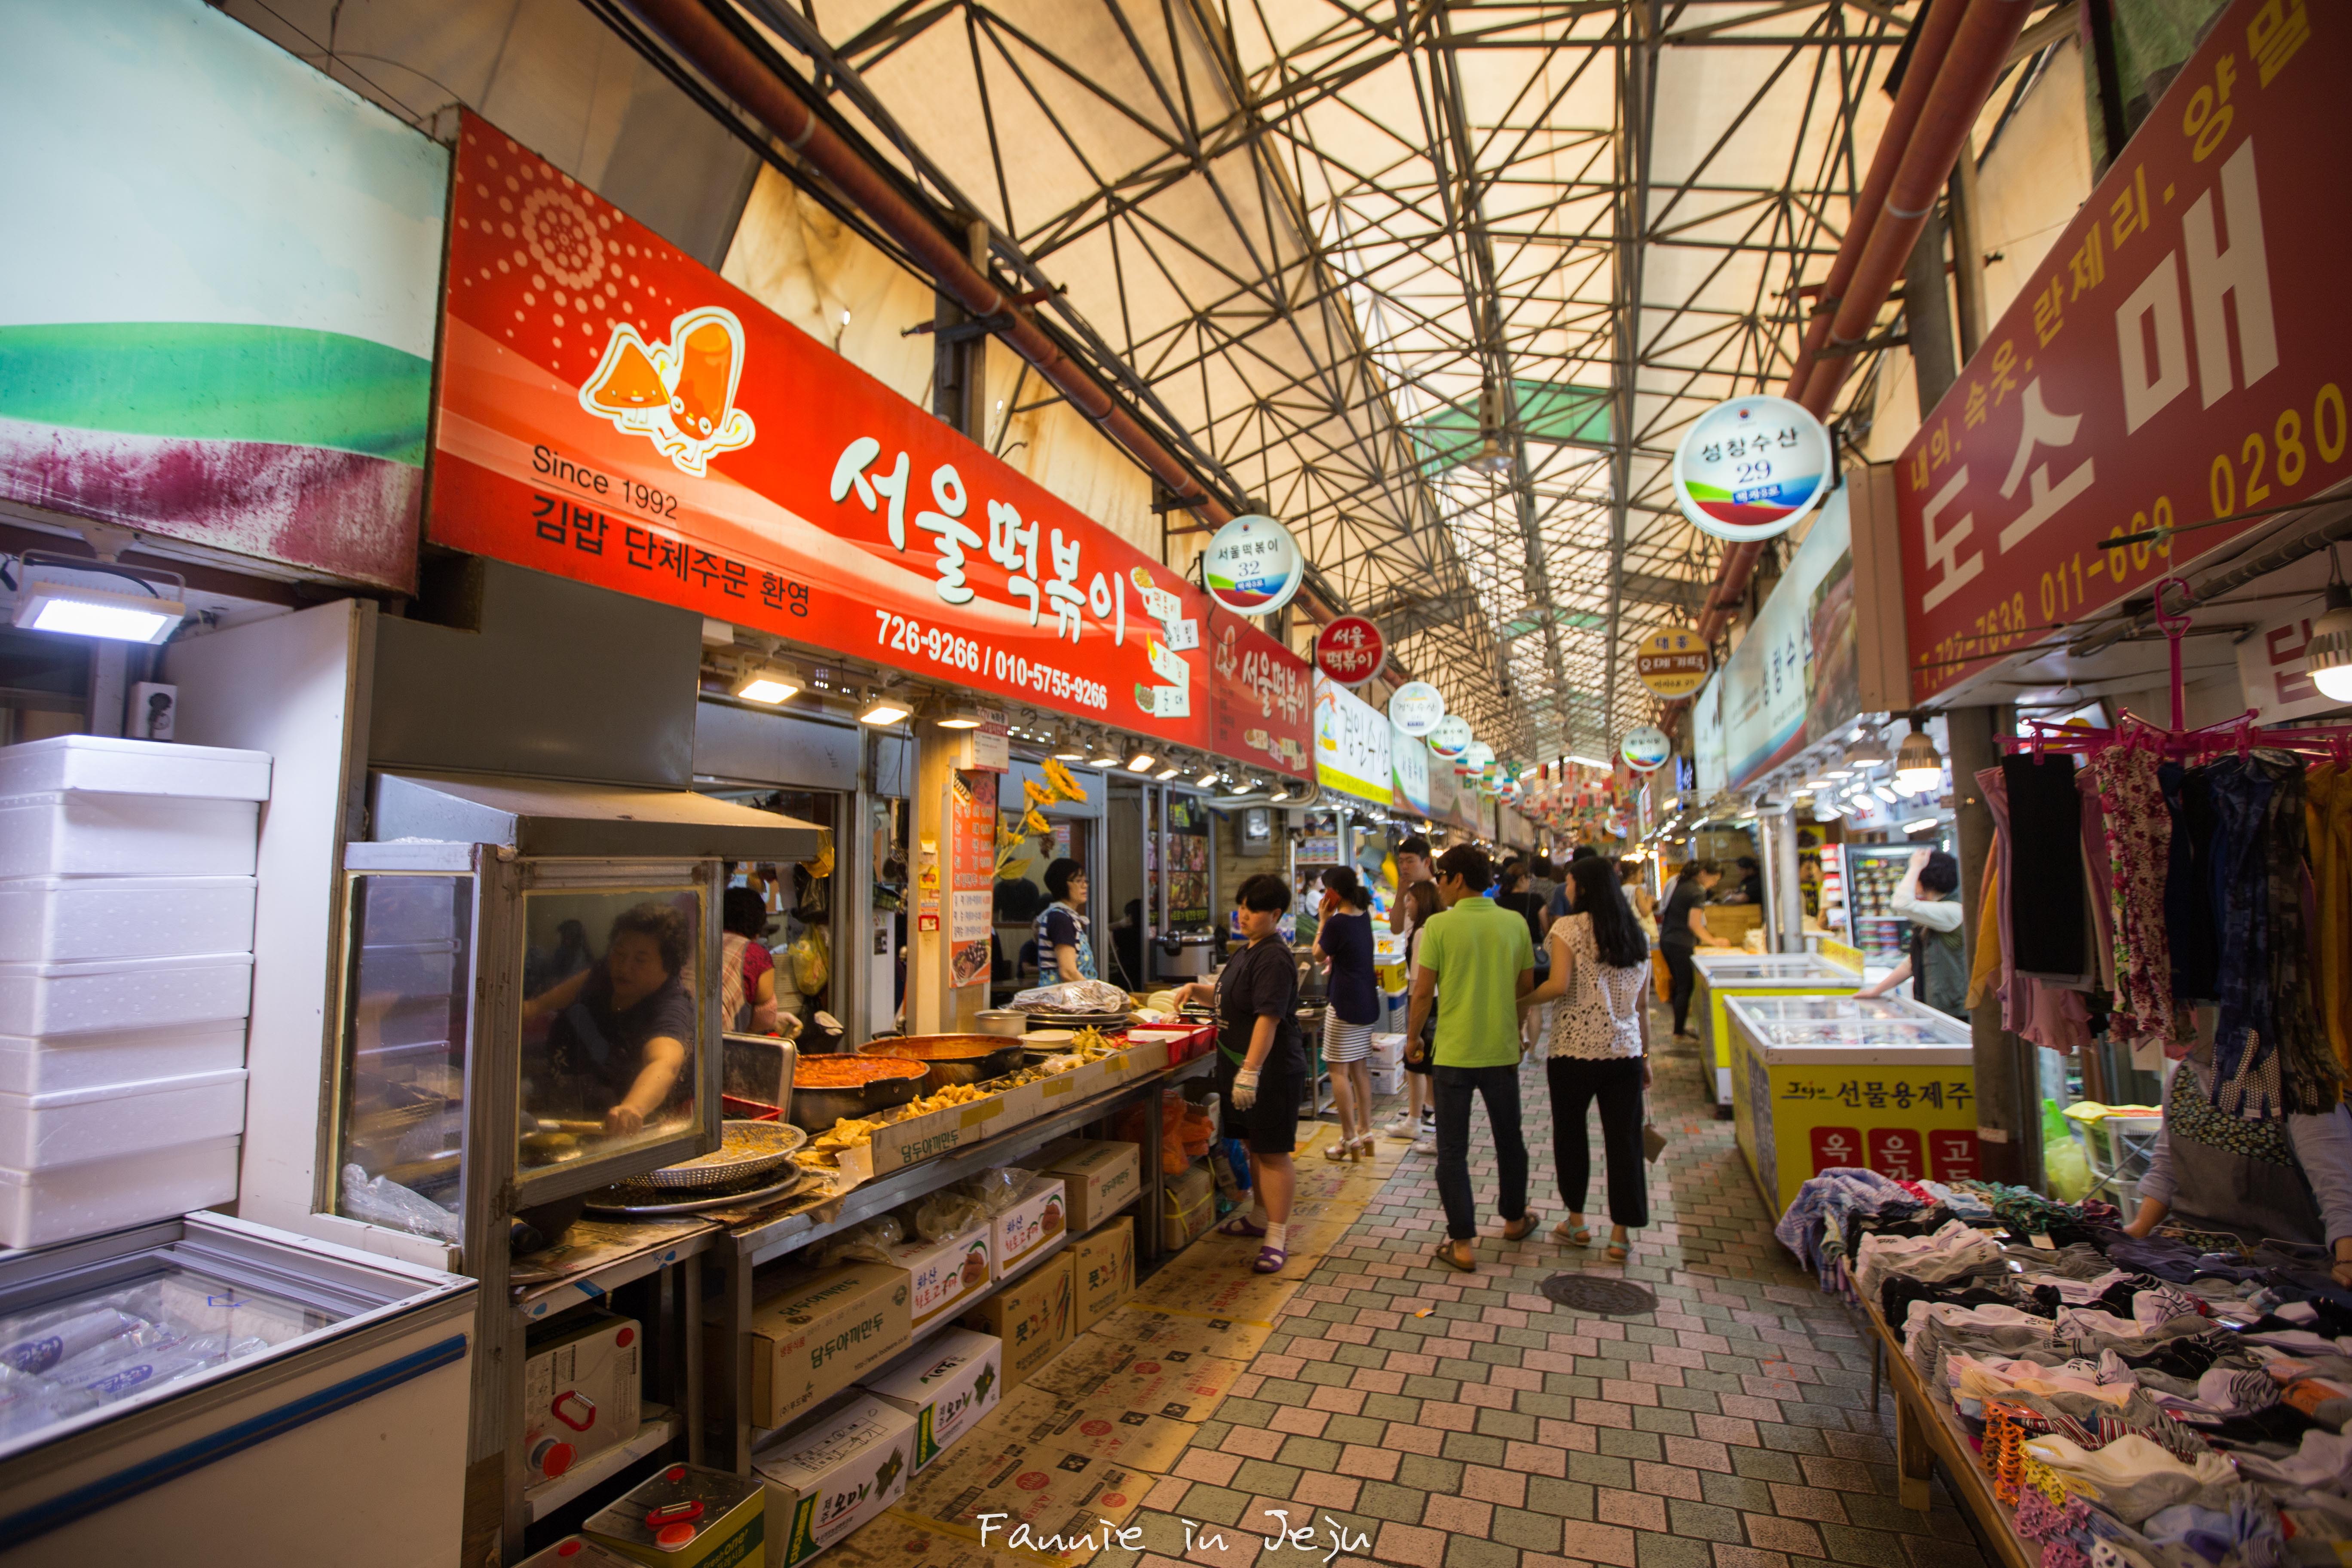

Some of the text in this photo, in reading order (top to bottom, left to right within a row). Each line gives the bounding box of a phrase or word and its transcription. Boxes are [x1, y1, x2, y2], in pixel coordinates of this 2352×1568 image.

[1923, 135, 2279, 615] 도소매
[1701, 426, 1798, 463] 성창수산
[2210, 383, 2348, 518] 0280
[532, 444, 678, 520] Since 1992
[1736, 458, 1771, 485] 29
[532, 494, 809, 617] 김밥 단체주문 환영
[830, 436, 1126, 647] 서울떡볶이
[1218, 537, 1278, 560] 서울떡볶이
[1238, 560, 1261, 577] 32
[1333, 625, 1366, 648] 서울
[876, 609, 979, 672] 726-9266
[995, 650, 1108, 710] 010-5755-9266
[1326, 651, 1373, 673] 떡볶이
[1242, 650, 1309, 726] 서울떡볶이
[1836, 1081, 1973, 1110] 선물용제주
[900, 1129, 959, 1163] 담두야끼만두
[1007, 1215, 1023, 1234] 화산
[917, 1267, 937, 1290] 화산
[780, 1336, 805, 1357] 냉동식품
[811, 1312, 884, 1369] 담두야끼만두
